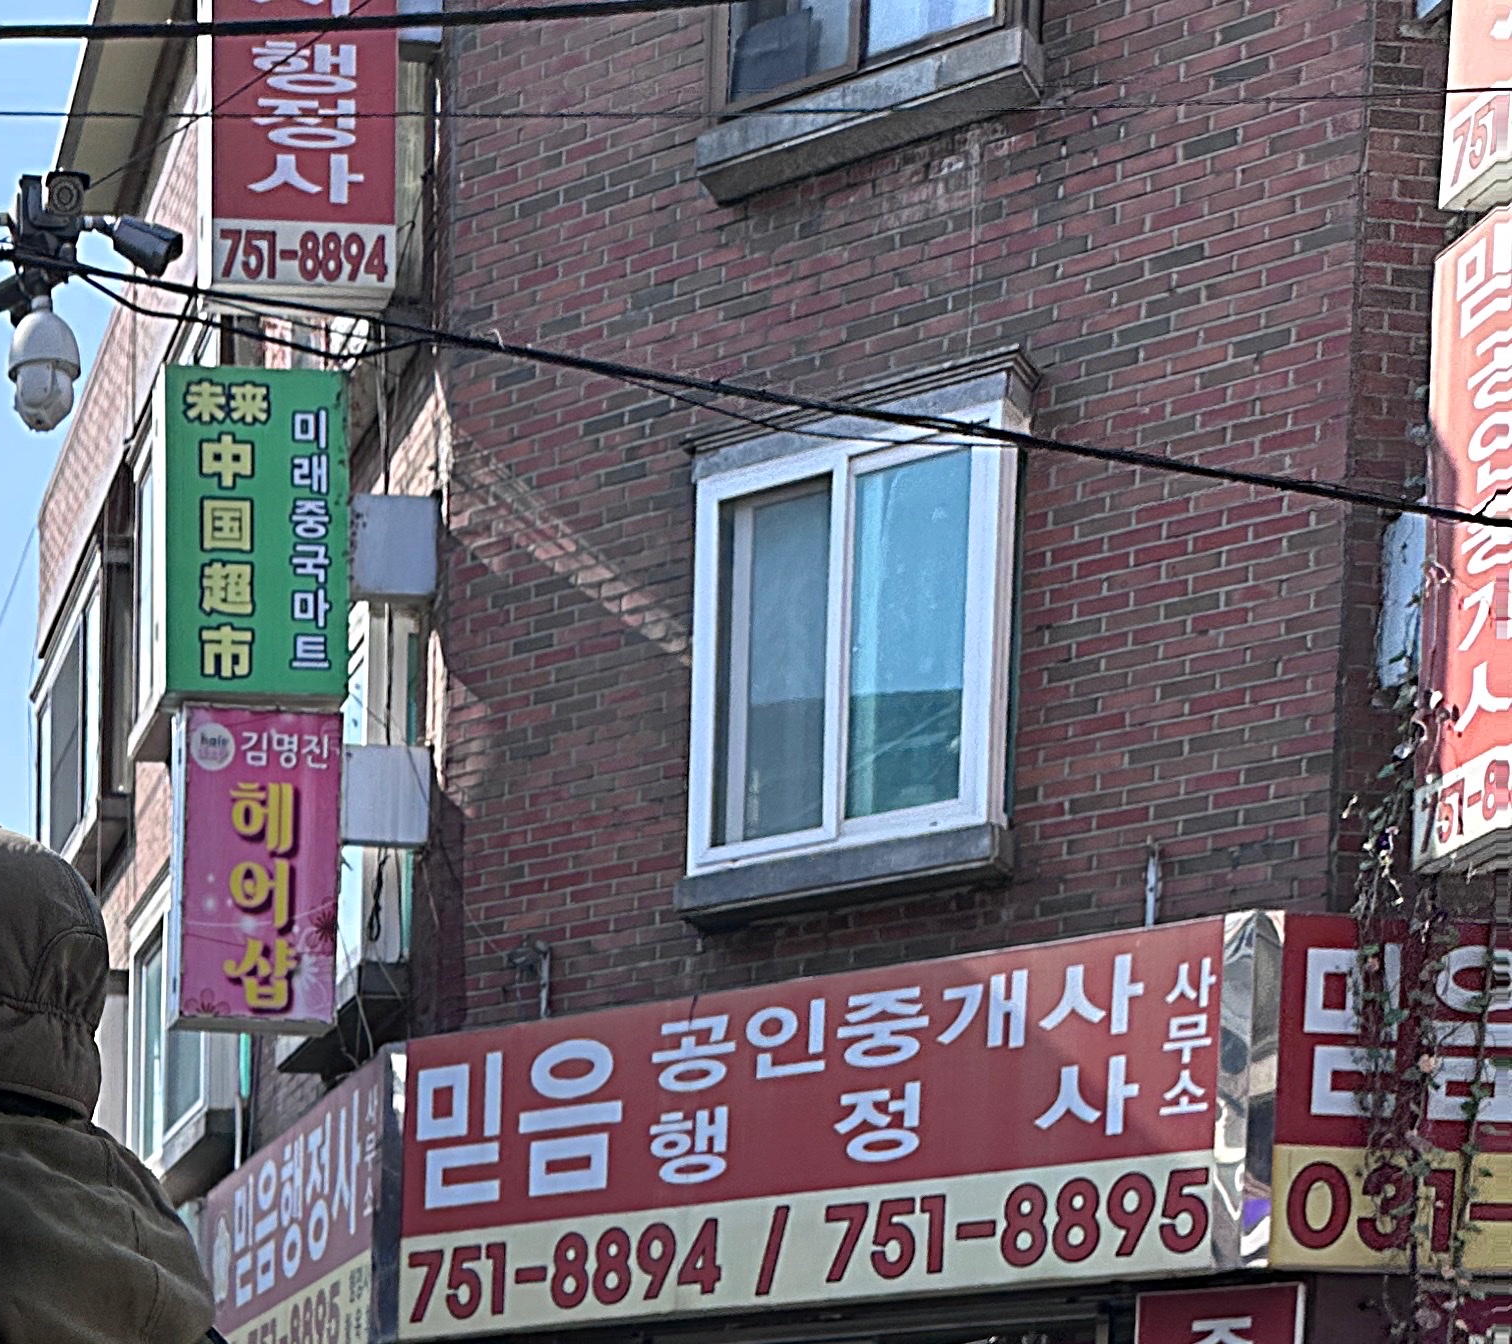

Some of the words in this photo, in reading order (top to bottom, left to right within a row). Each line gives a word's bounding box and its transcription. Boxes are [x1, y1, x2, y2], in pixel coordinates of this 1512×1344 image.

[248, 41, 364, 204] 행정사
[219, 229, 388, 283] 751-8894
[289, 408, 330, 669] 미래중국마트
[240, 731, 330, 769] 김명진
[223, 782, 298, 1010] 헤어샵
[651, 954, 1143, 1093] 공인중개사
[1159, 957, 1217, 1119] 사무소
[417, 1038, 623, 1210] 믿음
[408, 1218, 722, 1324] 751-8894
[826, 1167, 1210, 1284] 751-8895
